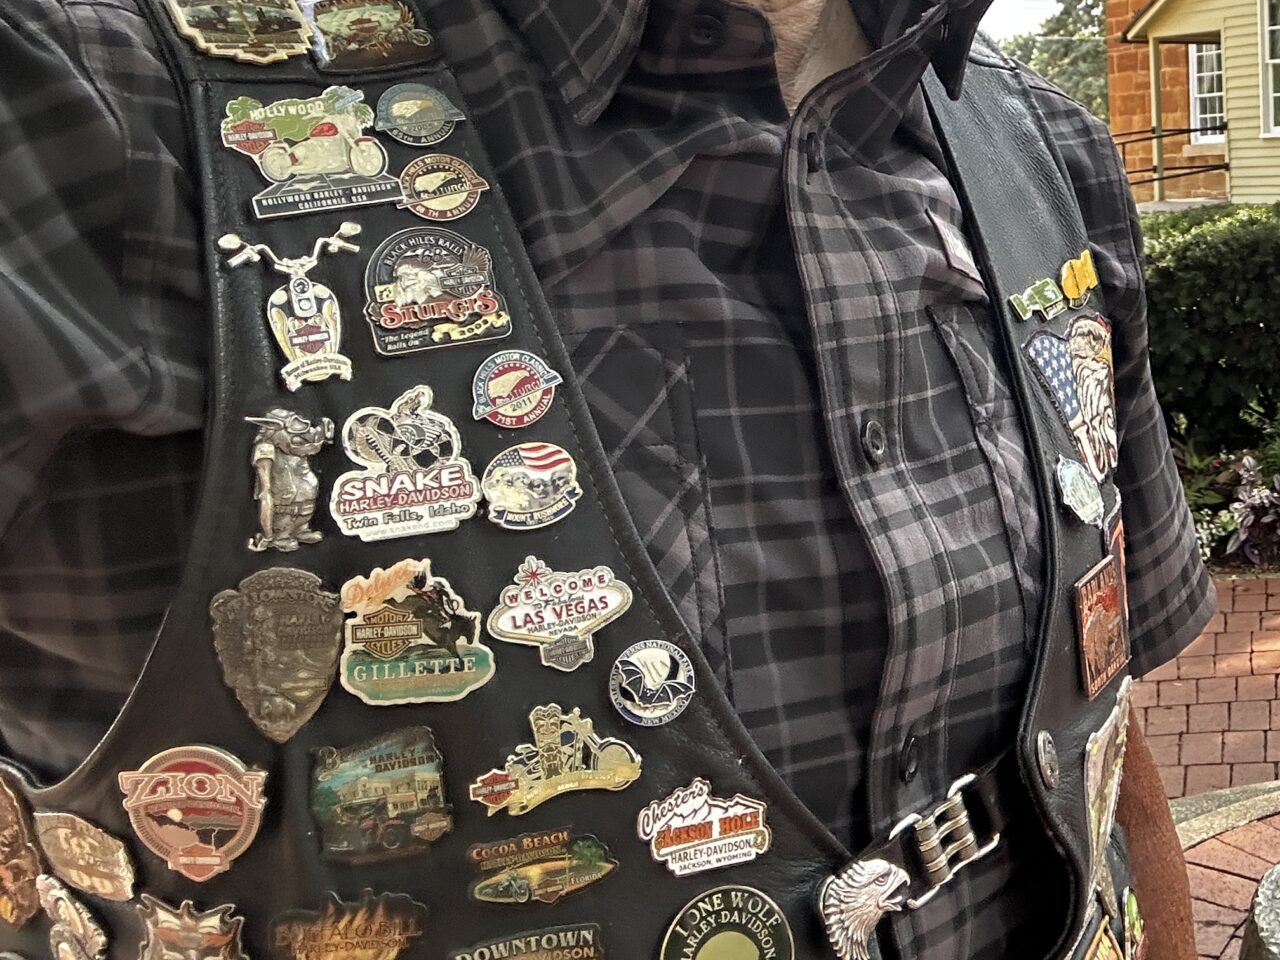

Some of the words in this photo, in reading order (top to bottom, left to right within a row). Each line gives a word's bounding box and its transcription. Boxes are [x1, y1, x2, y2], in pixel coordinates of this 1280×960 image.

[249, 100, 325, 121] HOLLYWOOD
[420, 122, 453, 143] ANNUAL
[261, 192, 312, 206] HOLLYWOOD
[351, 194, 368, 204] USA
[446, 192, 477, 218] ANNUAL
[383, 242, 409, 267] BLACK
[408, 236, 436, 246] HILLS
[380, 289, 498, 329] STURGIS
[479, 360, 496, 380] HILLS
[494, 352, 520, 364] MOTOR
[495, 413, 518, 426] 71ST
[523, 393, 552, 424] ANNUAL
[509, 396, 533, 412] 2011
[341, 467, 463, 500] SNAKE
[339, 484, 471, 514] HARLEY-DAVIDSON
[344, 516, 379, 531] Twin
[382, 509, 424, 525] Falls,
[428, 502, 471, 518] Idaho
[506, 574, 606, 605] WELCOME
[510, 610, 546, 630] LAS
[552, 595, 609, 620] VEGAS
[527, 612, 598, 634] HARLEY-DAVIDSON
[355, 624, 419, 640] HARLEY-DAVIDSON
[548, 624, 579, 637] NEVADA
[353, 656, 477, 682] GILLETTE
[121, 772, 263, 809] ZION
[641, 782, 706, 839] Chester's
[656, 820, 714, 850] JACKSON
[719, 810, 761, 836] HOLE
[472, 843, 517, 860] COCOA
[521, 831, 569, 850] BEACH
[669, 838, 753, 865] HARLEY-DAVIDSON
[715, 851, 753, 864] WYOMING
[674, 893, 725, 938] LONE
[730, 891, 782, 928] WOLF
[454, 929, 594, 960] DOWNTOWN
